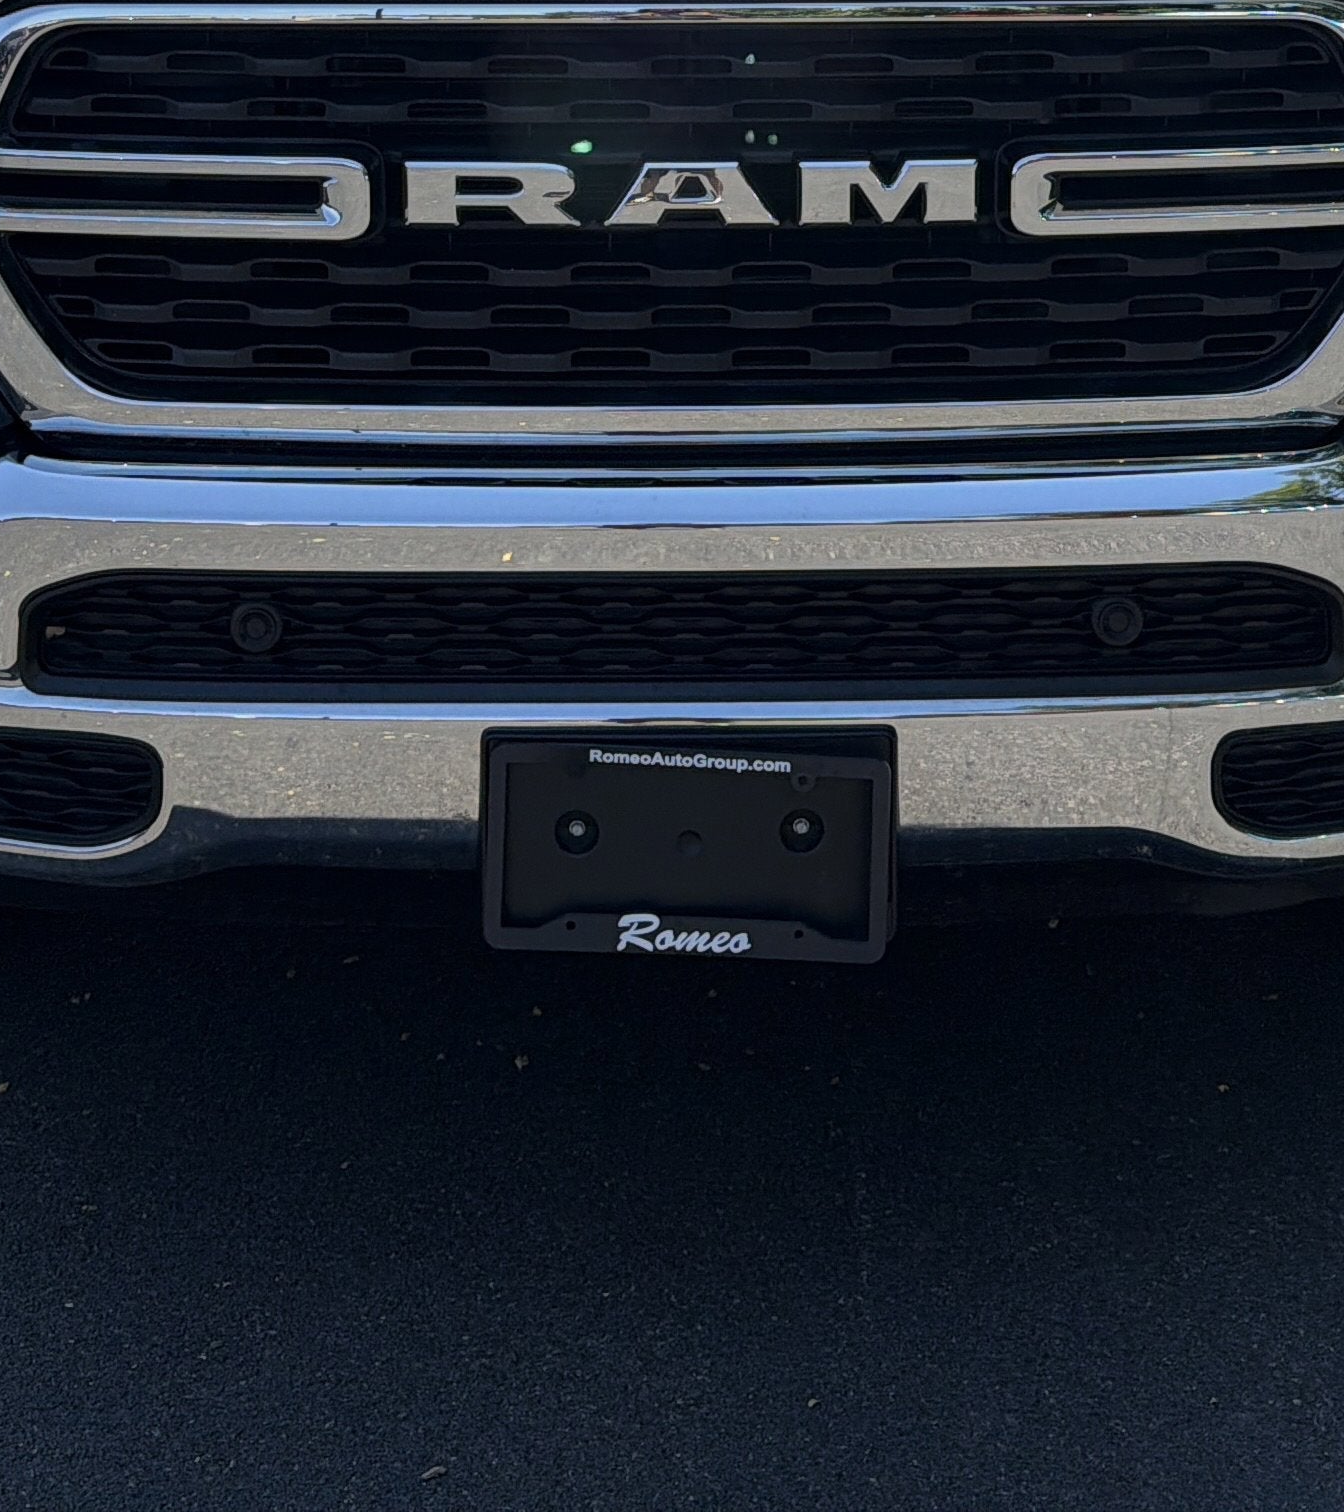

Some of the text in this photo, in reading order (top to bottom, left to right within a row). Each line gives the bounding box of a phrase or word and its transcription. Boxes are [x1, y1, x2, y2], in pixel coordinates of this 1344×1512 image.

[404, 160, 979, 226] RAM
[589, 748, 792, 774] RomeoAutoGroup.com
[616, 913, 752, 955] Romeo
